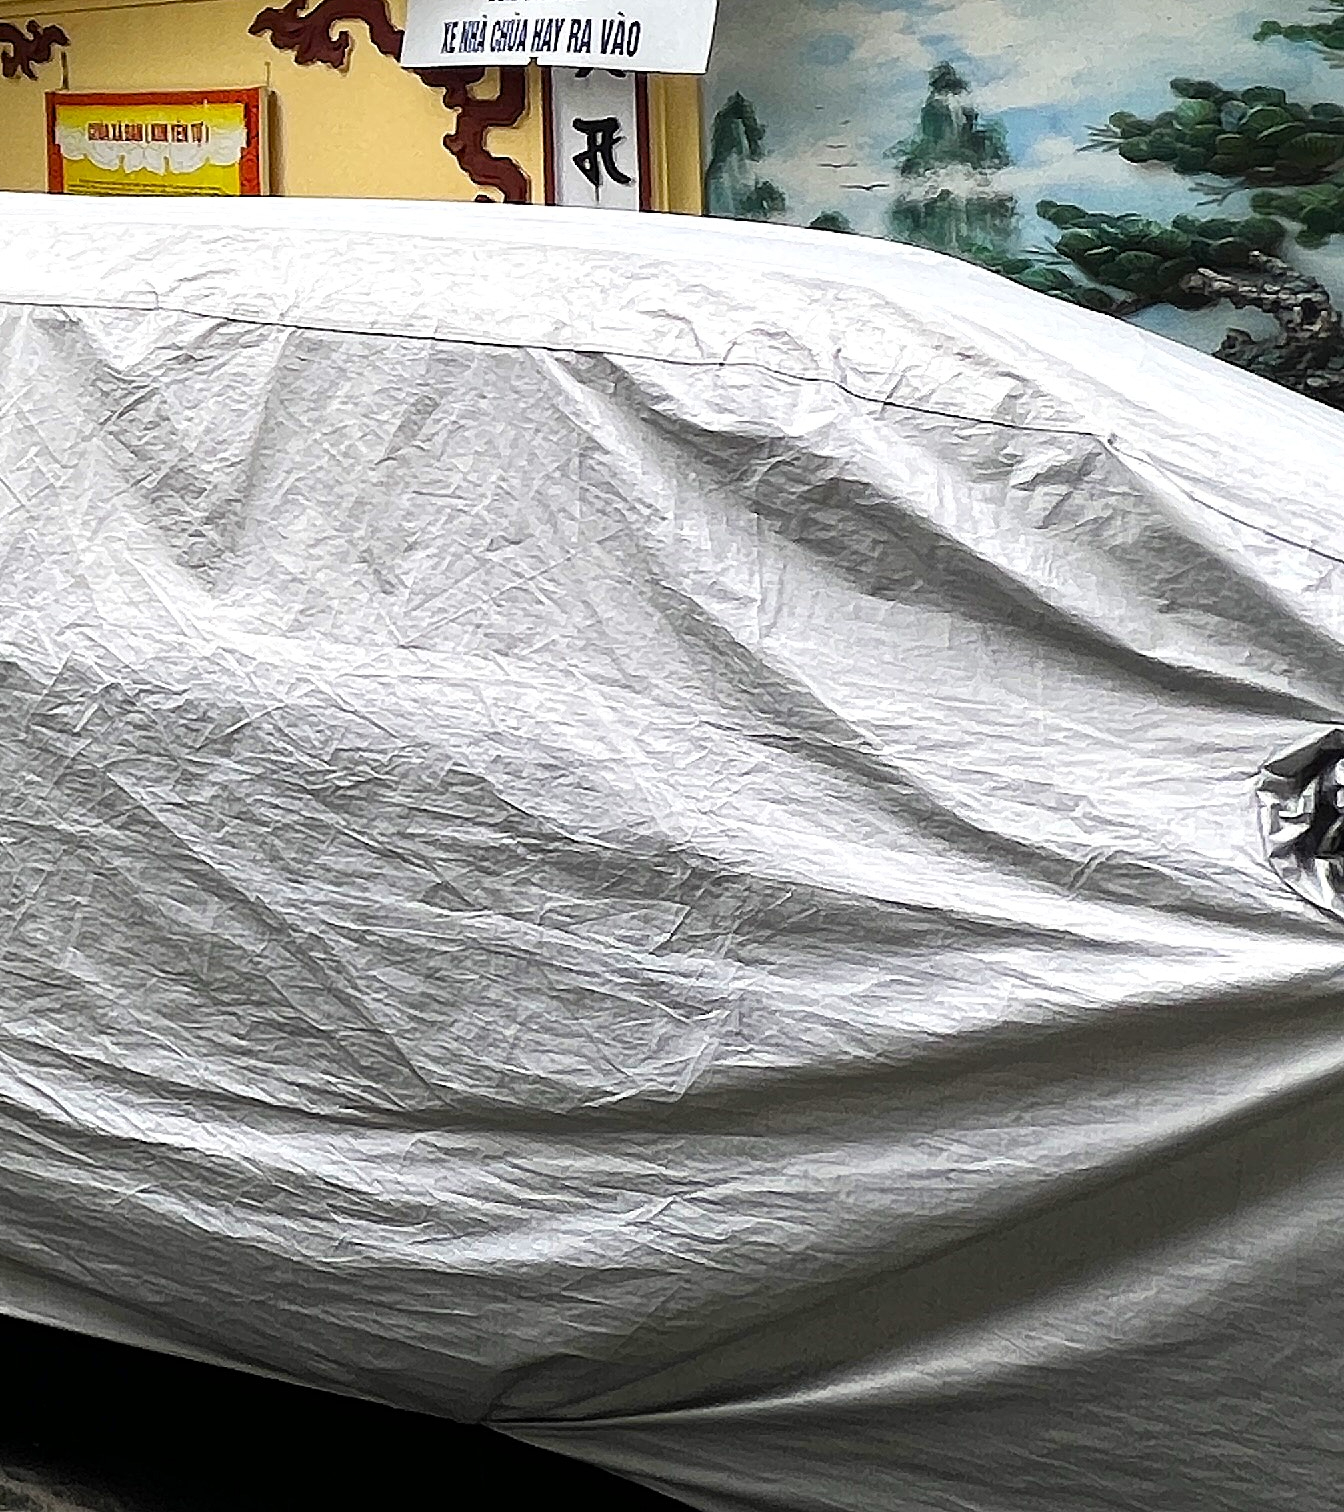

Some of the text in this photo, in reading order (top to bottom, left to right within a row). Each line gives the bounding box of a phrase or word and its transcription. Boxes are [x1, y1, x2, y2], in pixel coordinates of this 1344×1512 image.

[441, 11, 642, 57] XE NHÀ CHÙA HAY RA VÀO
